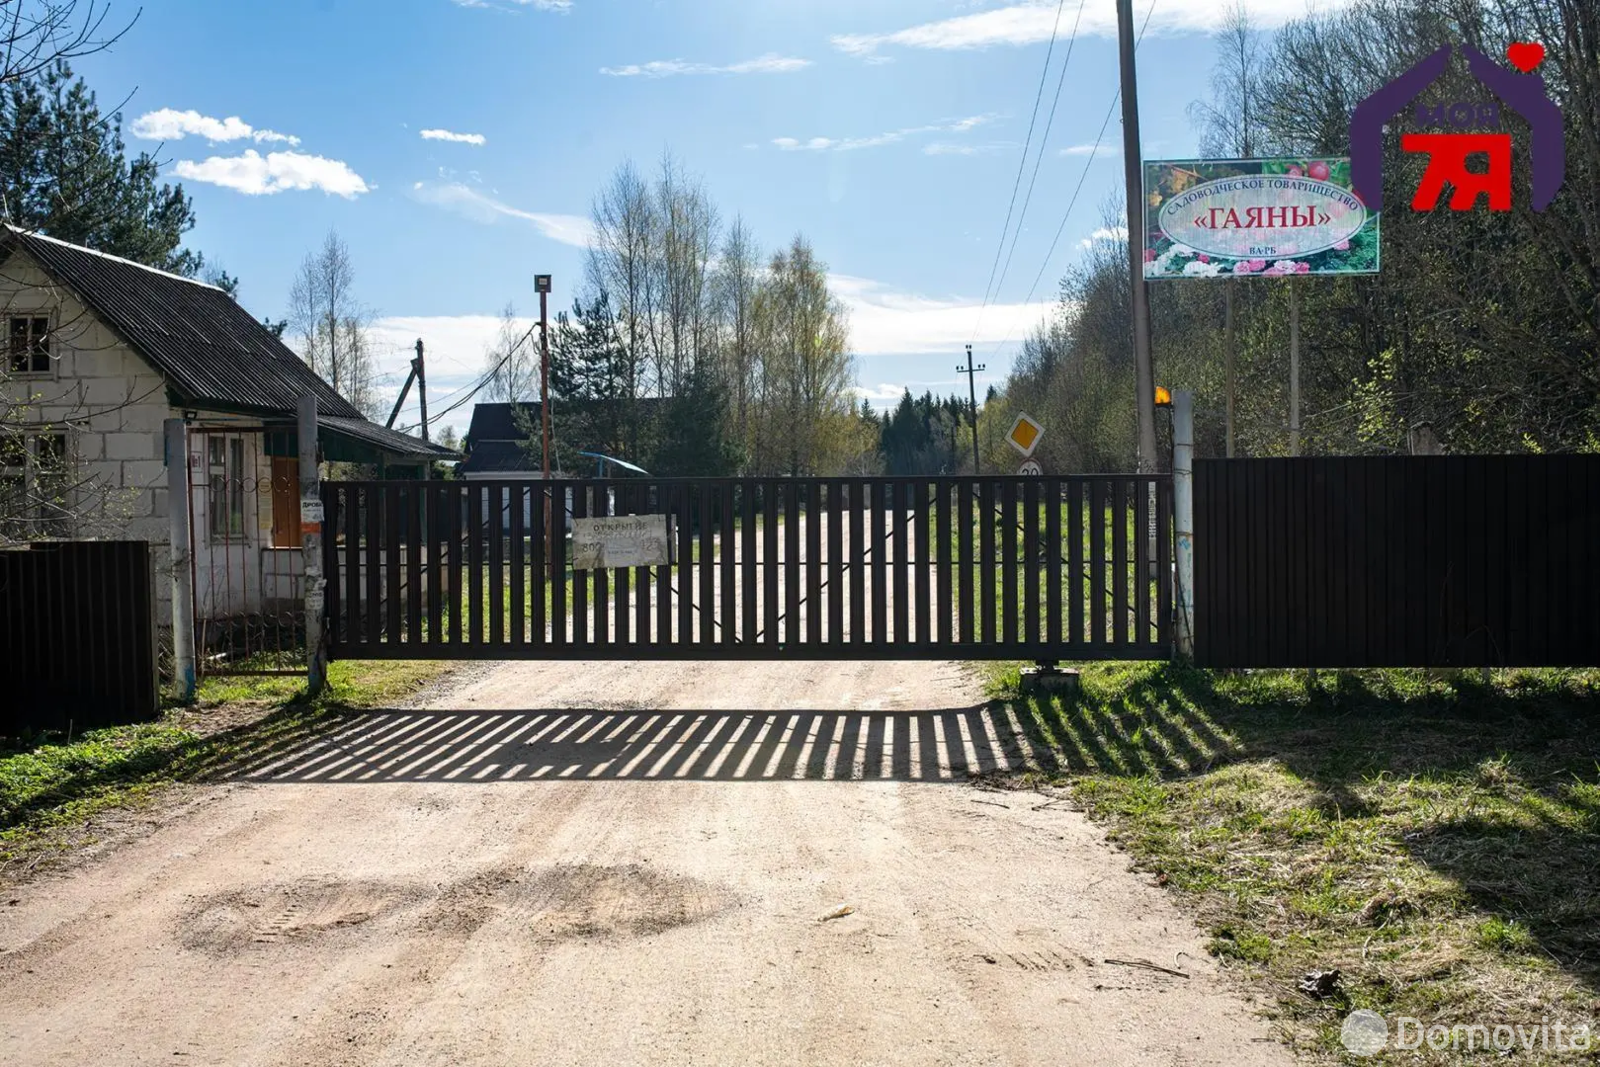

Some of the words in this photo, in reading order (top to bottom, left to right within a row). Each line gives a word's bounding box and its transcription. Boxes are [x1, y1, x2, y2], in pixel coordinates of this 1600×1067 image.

[1167, 178, 1265, 216] САДОВОДЧЕСКОЕ
[1267, 179, 1359, 212] ТОВАРИЩЕСТВО
[1193, 204, 1332, 230] «ГАЯНЫ»
